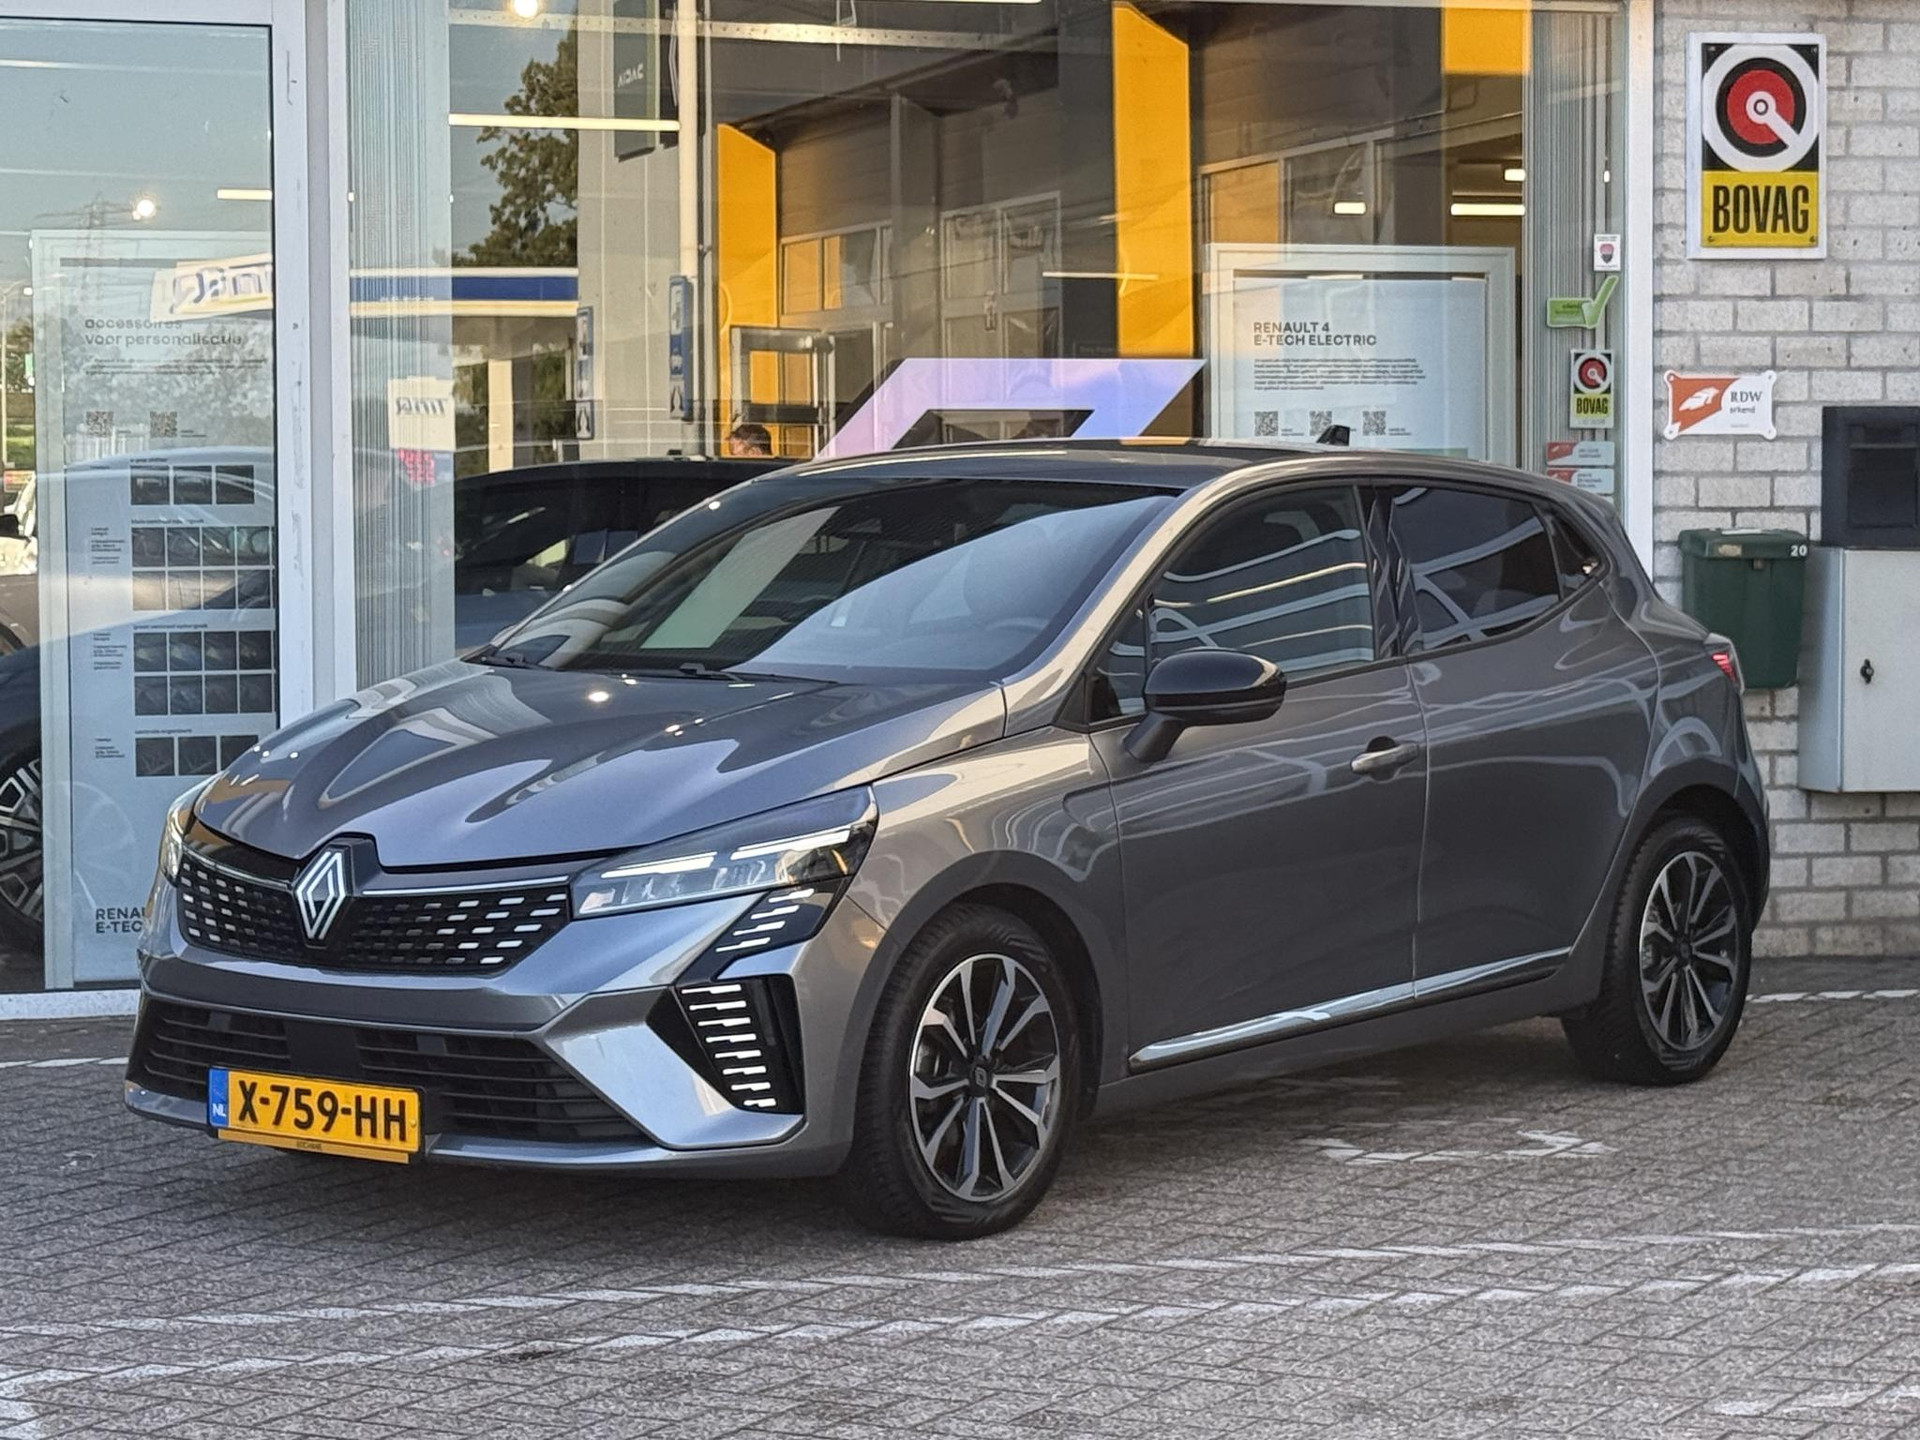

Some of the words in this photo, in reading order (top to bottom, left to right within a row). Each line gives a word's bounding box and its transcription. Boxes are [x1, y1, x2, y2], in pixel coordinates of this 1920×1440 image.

[1712, 184, 1809, 234] BOVAG
[84, 318, 182, 330] accessoires
[1253, 322, 1319, 333] RENAULT
[1322, 322, 1330, 333] 4
[84, 334, 125, 346] voor
[1253, 334, 1305, 346] E-TECH
[1308, 334, 1377, 346] ELECTRIC
[1730, 391, 1762, 403] RDW
[1576, 397, 1609, 415] BOVAG
[1790, 545, 1808, 557] 20
[212, 1103, 227, 1117] NL
[238, 1079, 407, 1143] X-759-HH
